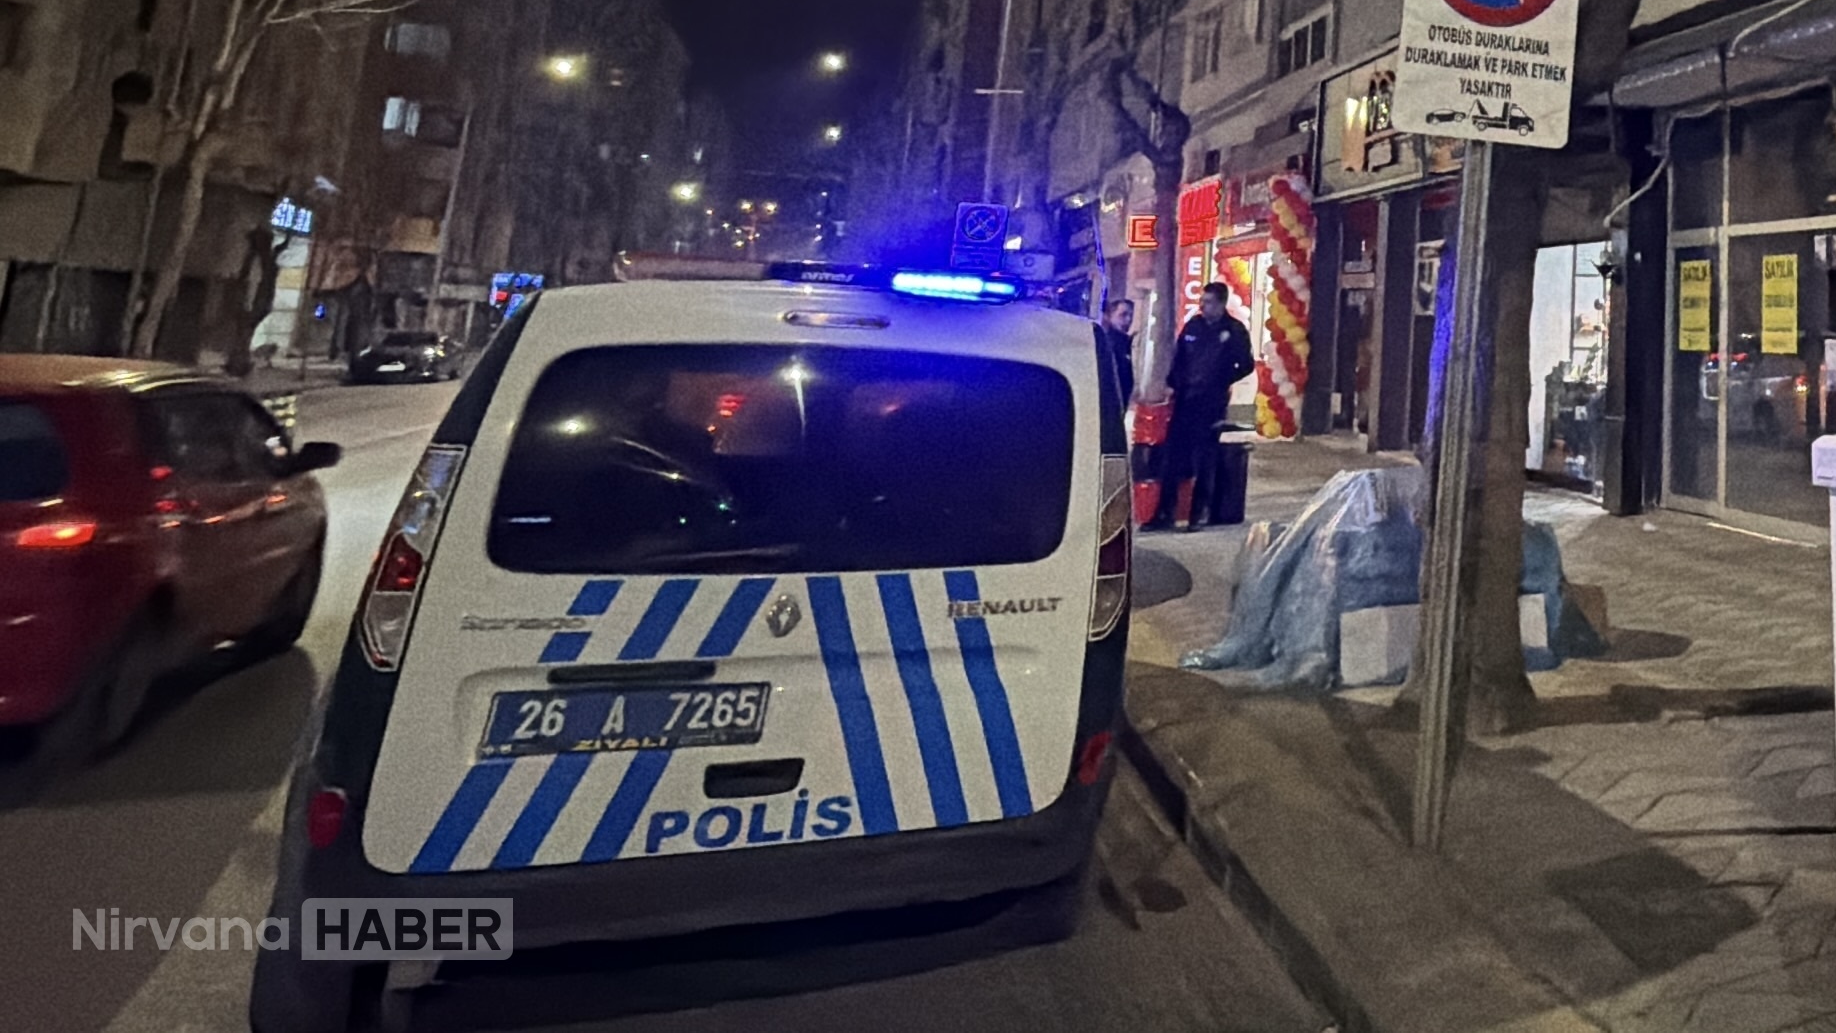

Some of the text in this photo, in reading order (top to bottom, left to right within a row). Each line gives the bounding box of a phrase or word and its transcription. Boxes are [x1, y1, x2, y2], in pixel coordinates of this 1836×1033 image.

[1428, 24, 1550, 57] OTOBÜS DURAKLARINA
[1404, 46, 1567, 83] DURAKLAMAK VE PARK ETMEK
[1458, 77, 1512, 99] YASAKTIR
[947, 596, 1063, 618] RENAULT
[513, 690, 760, 740] 26 A 7265
[644, 787, 853, 855] POLİS
